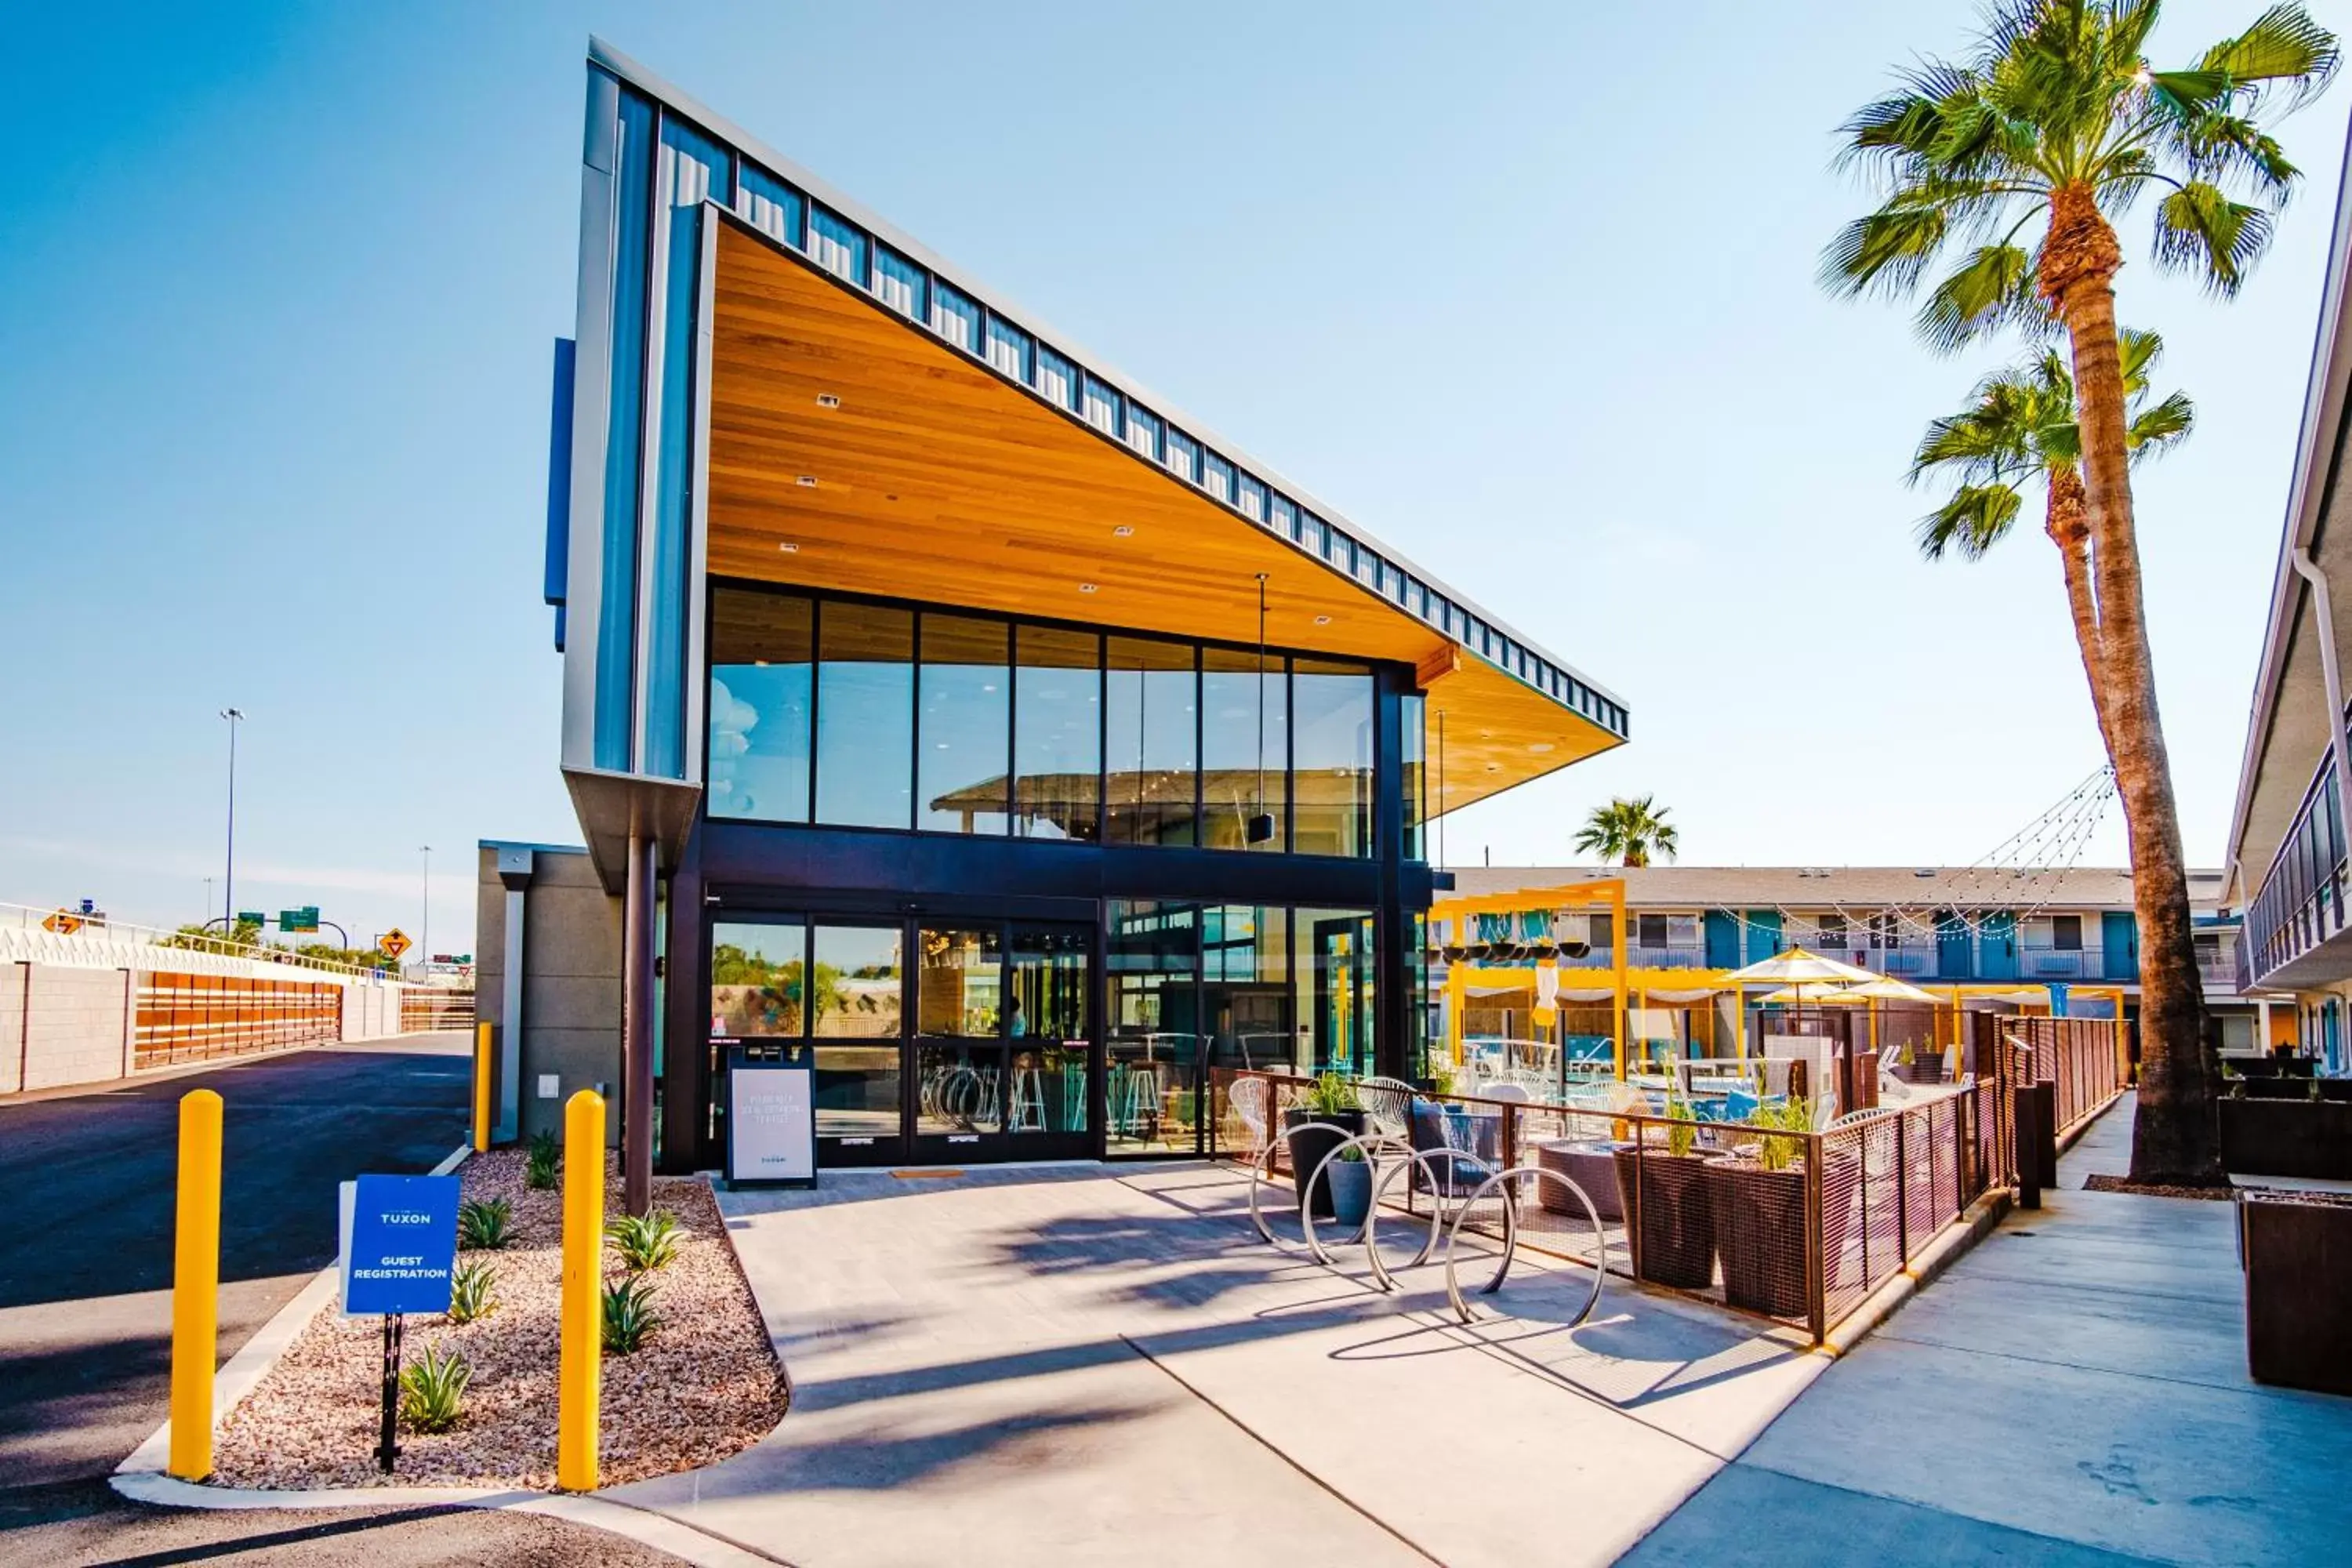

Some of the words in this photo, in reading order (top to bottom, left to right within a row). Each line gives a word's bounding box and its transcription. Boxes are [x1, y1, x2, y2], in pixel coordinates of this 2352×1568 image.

[380, 1214, 430, 1224] TUXON
[381, 1256, 423, 1266] GUEST
[354, 1269, 447, 1279] REGISTRATION
